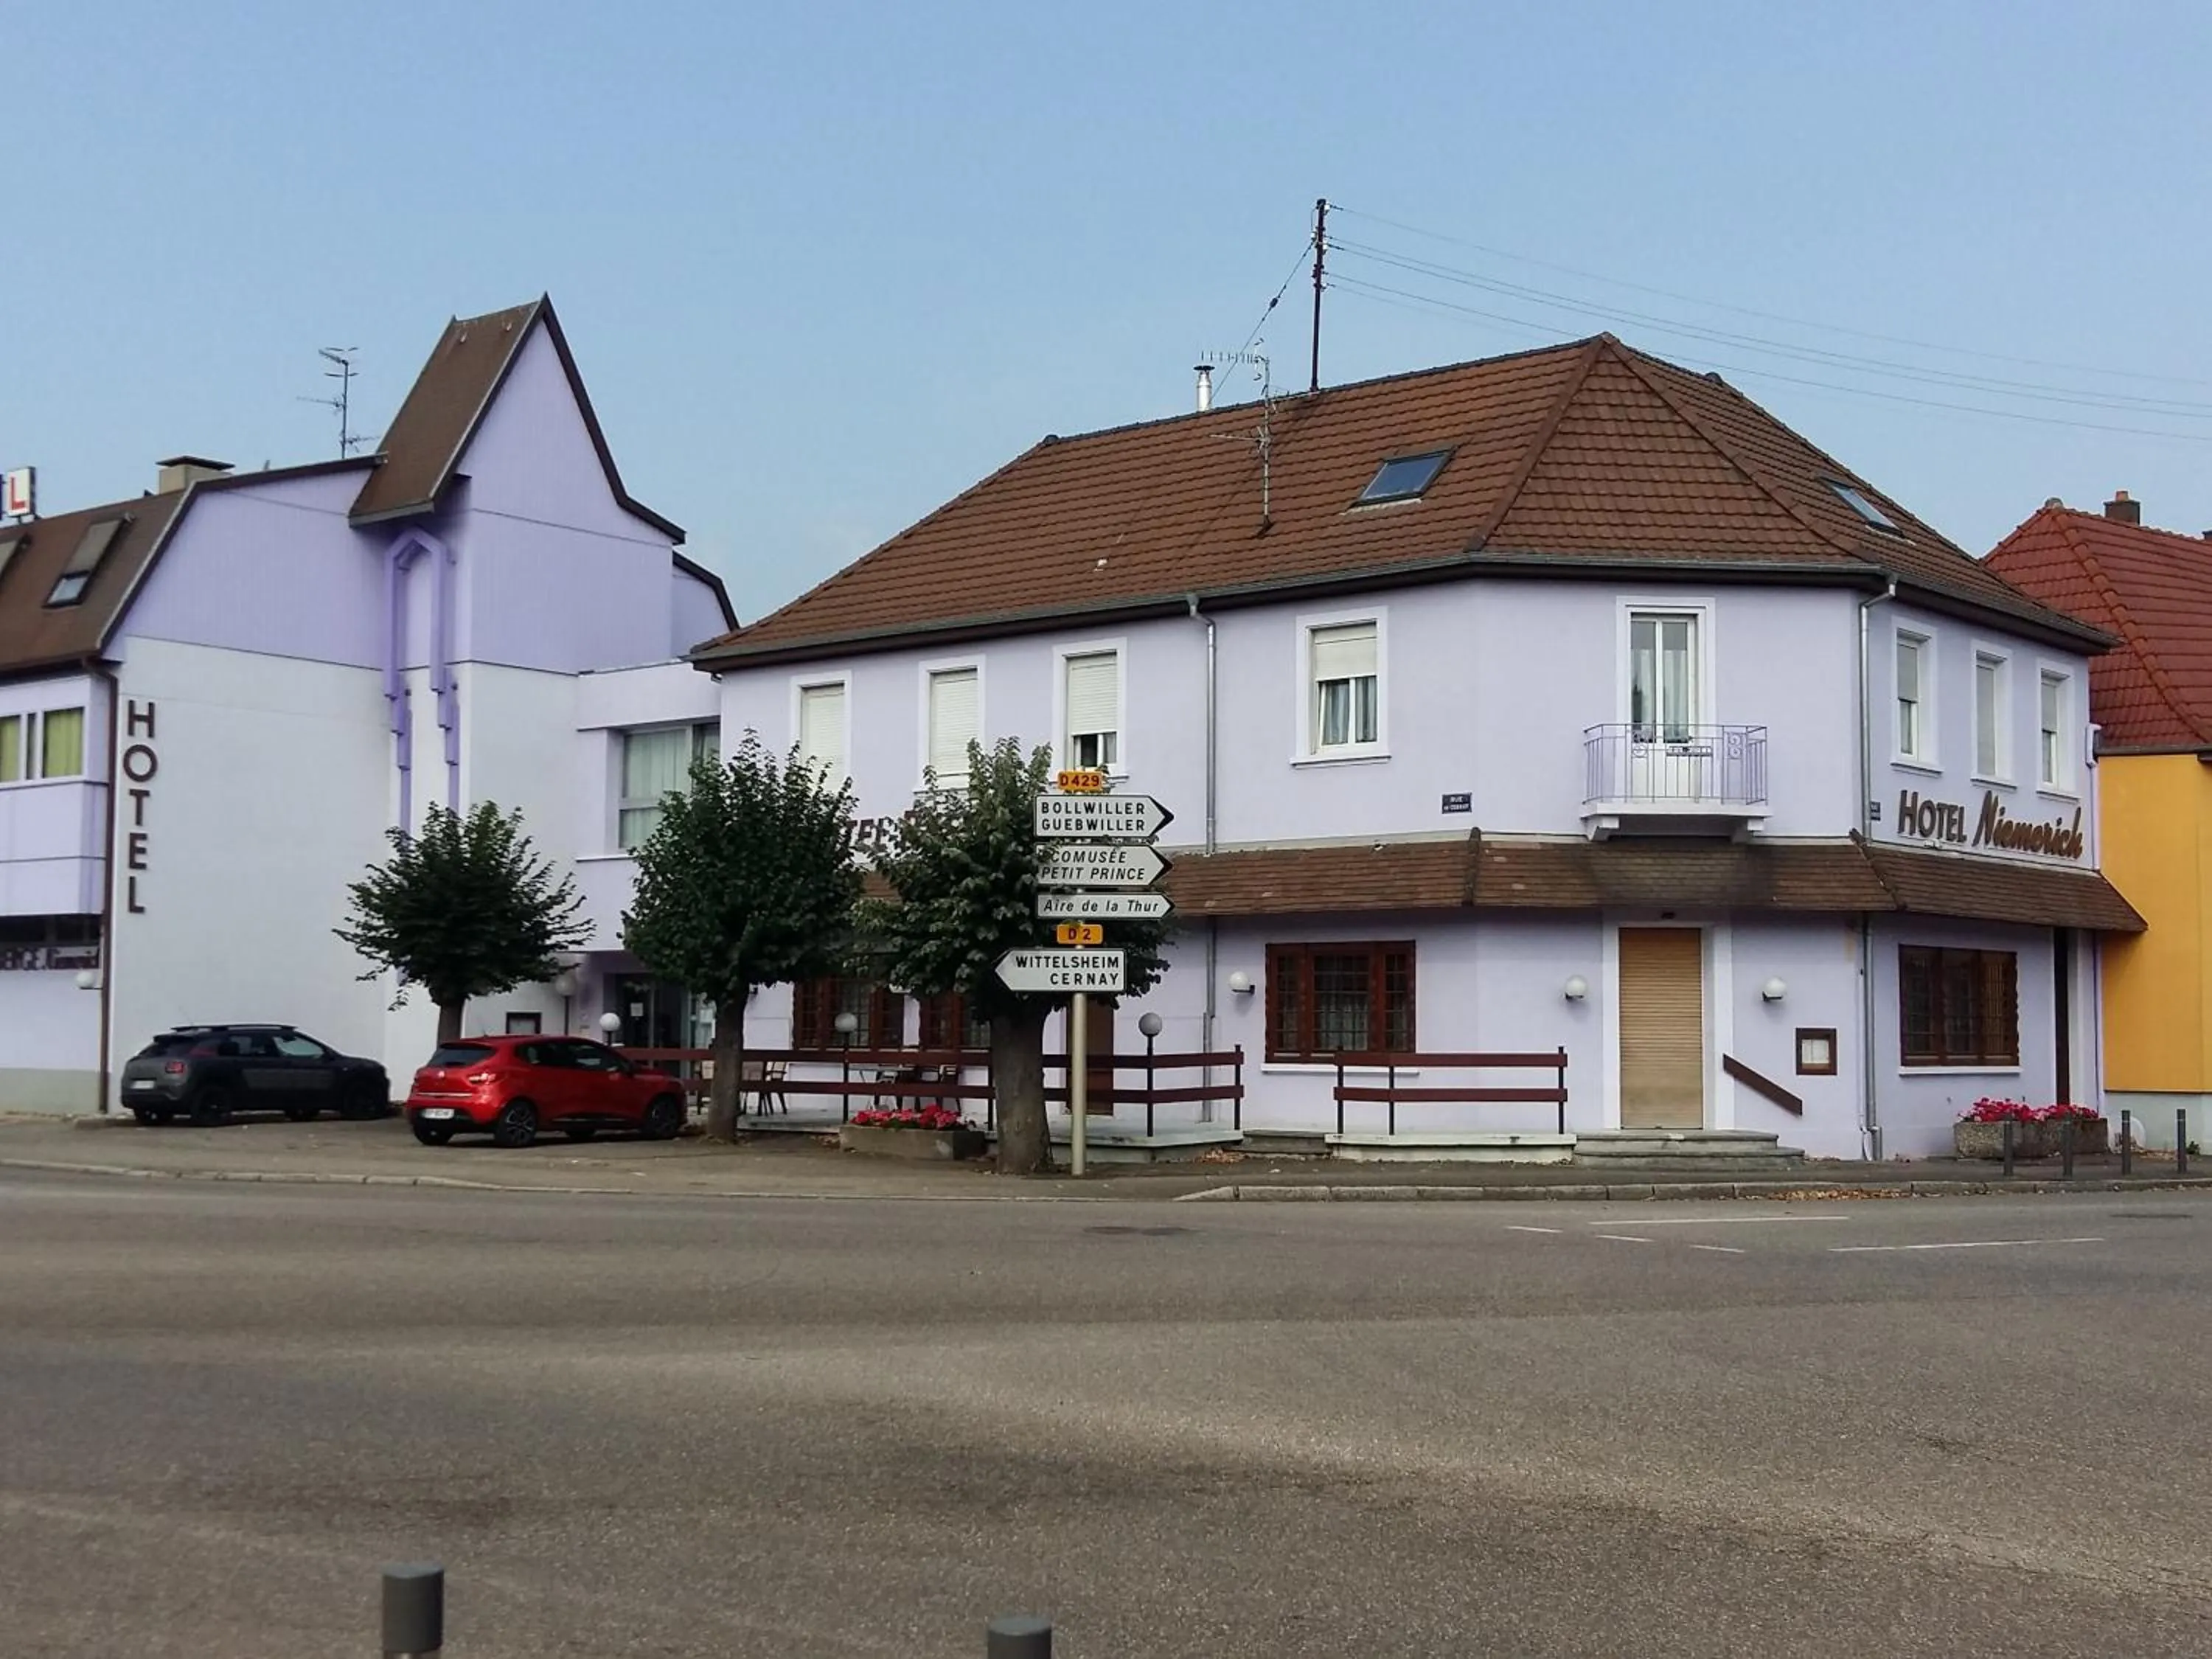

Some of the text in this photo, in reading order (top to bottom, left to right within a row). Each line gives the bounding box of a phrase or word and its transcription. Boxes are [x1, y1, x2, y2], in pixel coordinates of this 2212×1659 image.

[122, 700, 158, 914] HOTEL
[1042, 802, 1145, 815] BOLLWILLER
[1898, 790, 1967, 844] HOTEL
[1042, 818, 1145, 831] GUEBWILLER
[1042, 848, 1127, 863] COMUSÉE
[1041, 867, 1145, 880] PETIT PRINCE
[1044, 901, 1159, 912] Aire de la Thur
[1015, 956, 1119, 968] WITTELSHEIM
[1050, 973, 1119, 985] CERNAY
